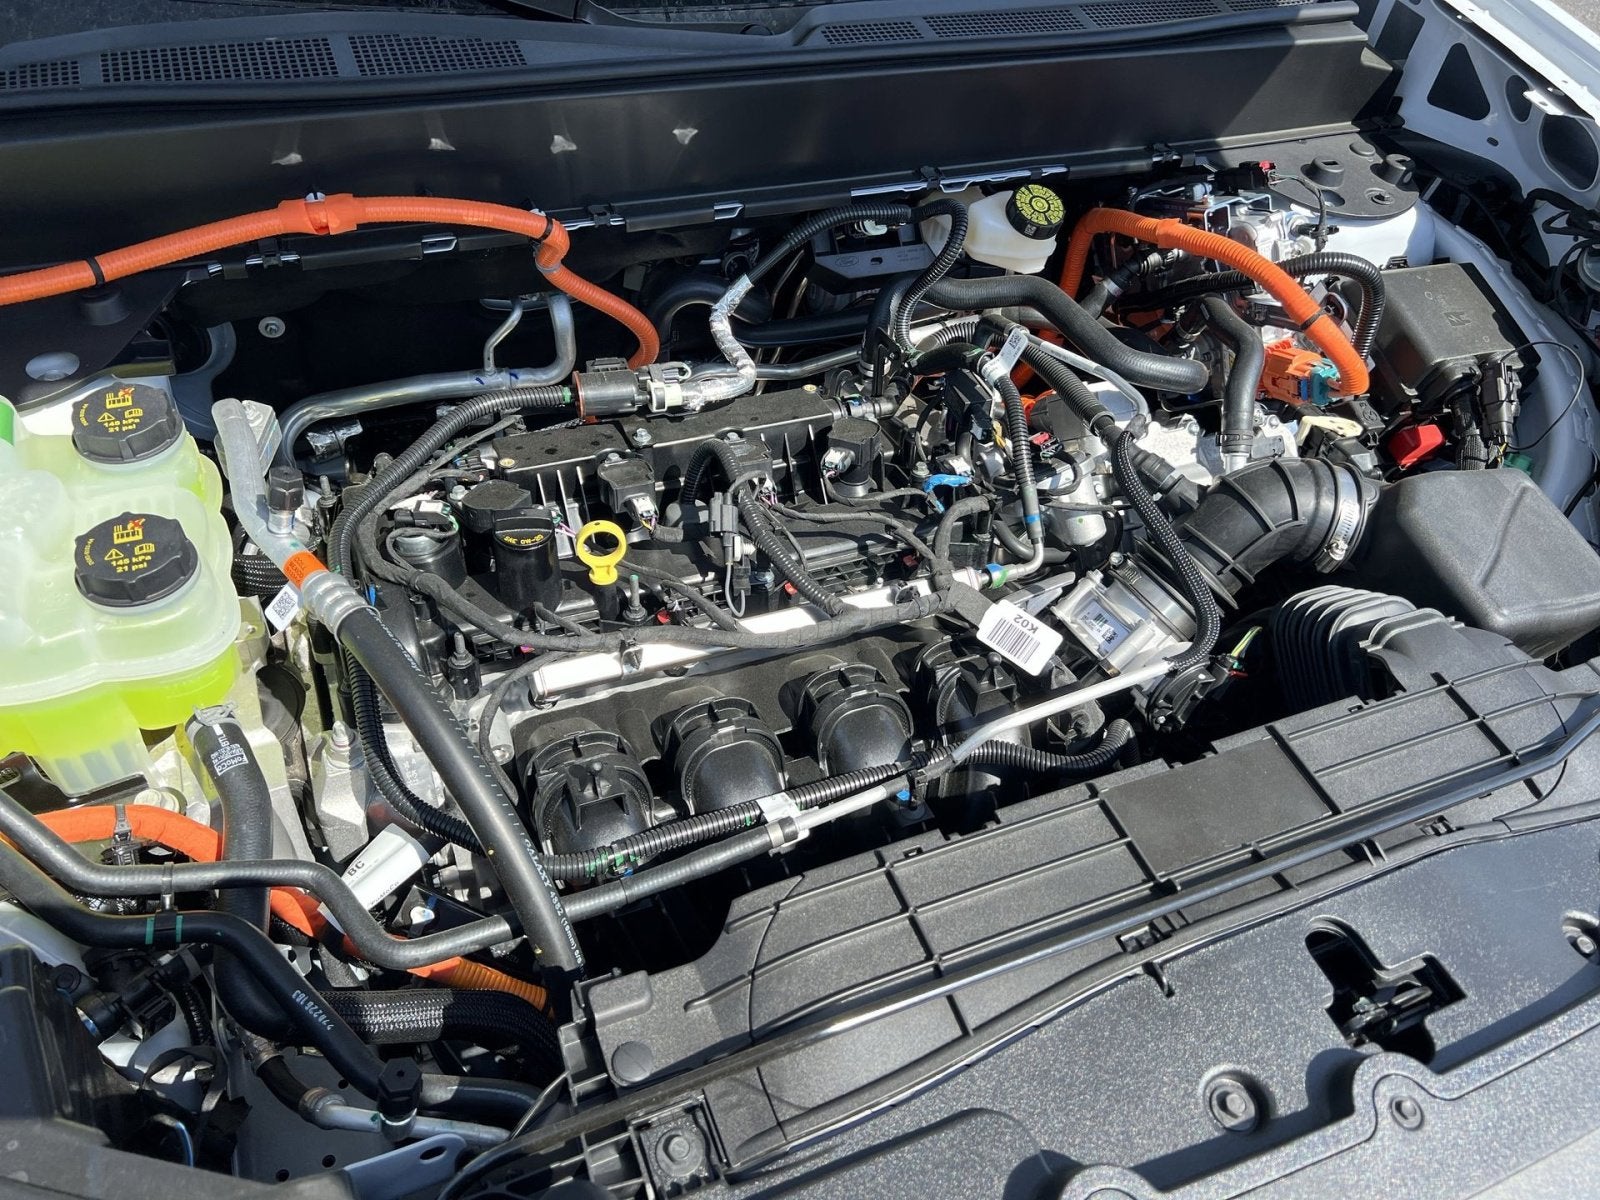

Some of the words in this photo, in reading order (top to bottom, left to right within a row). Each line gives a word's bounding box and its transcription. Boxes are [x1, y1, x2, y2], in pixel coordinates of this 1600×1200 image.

[132, 562, 147, 571] psi
[347, 860, 365, 876] BC
[524, 838, 552, 888] GALAXY
